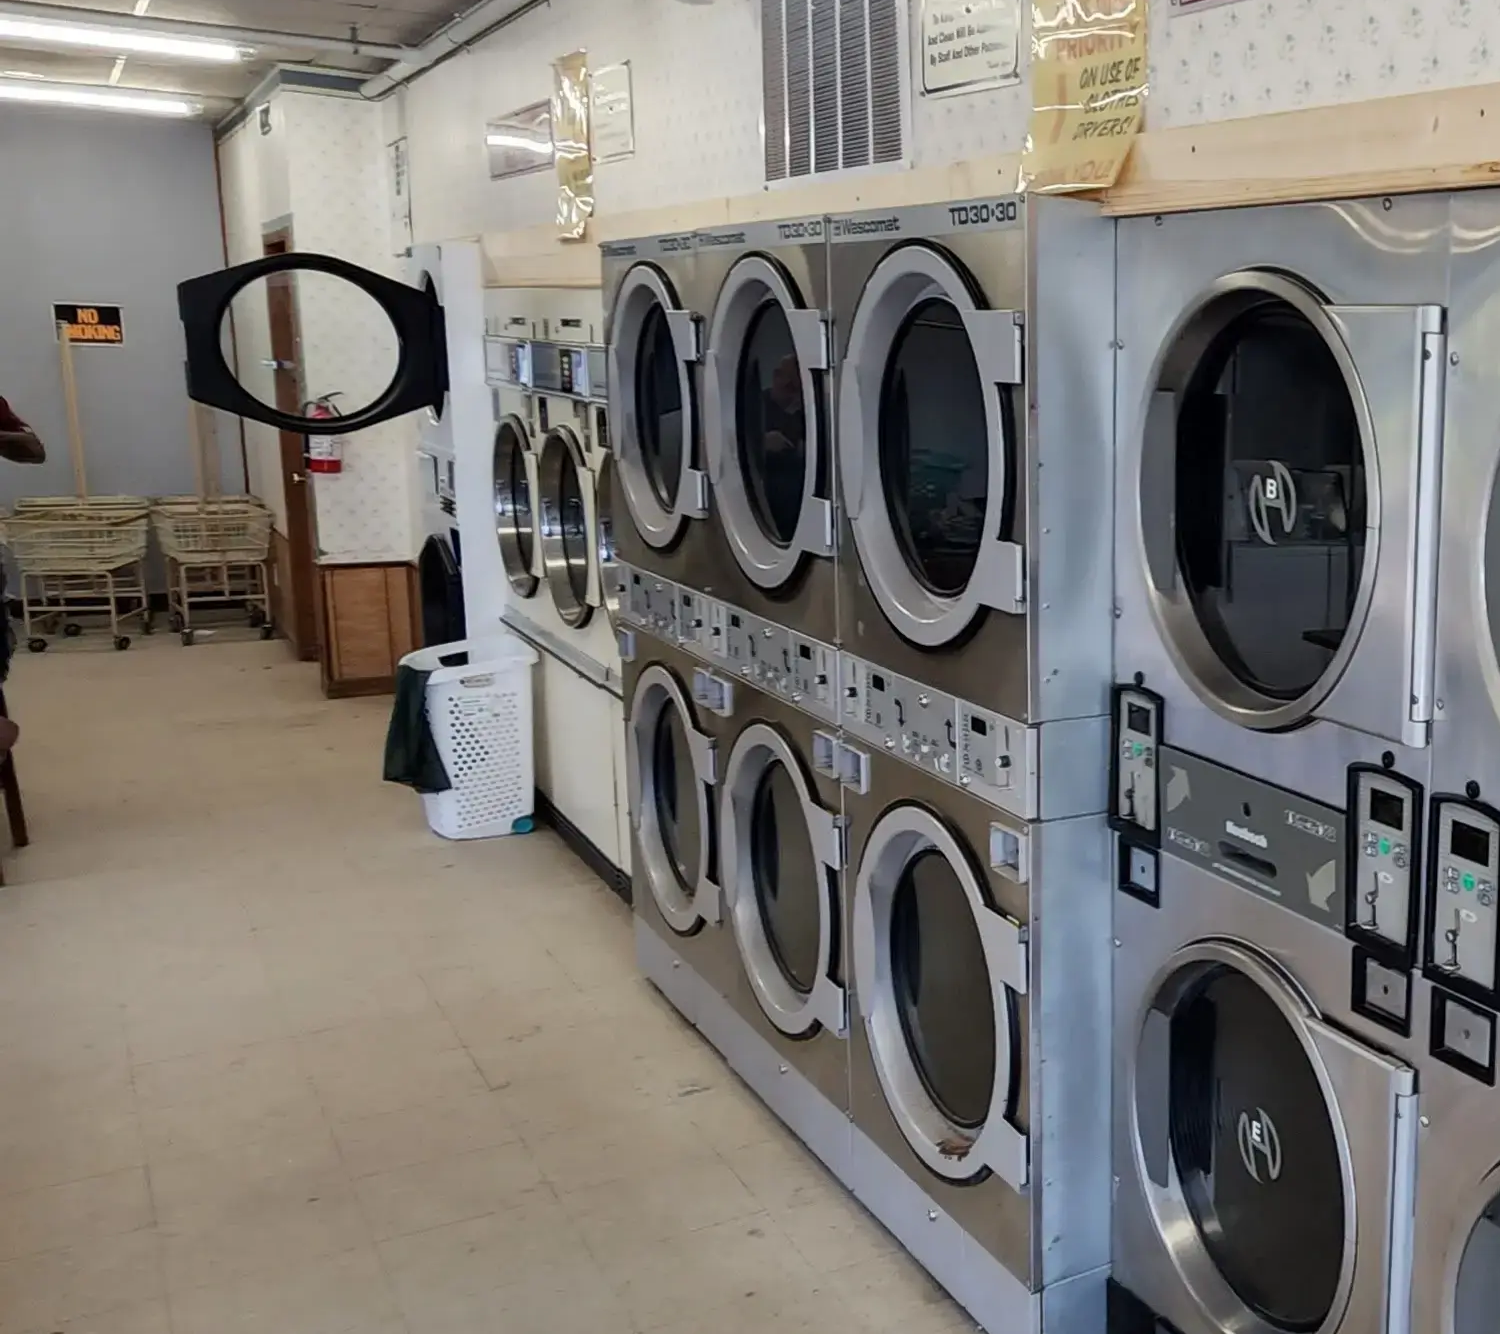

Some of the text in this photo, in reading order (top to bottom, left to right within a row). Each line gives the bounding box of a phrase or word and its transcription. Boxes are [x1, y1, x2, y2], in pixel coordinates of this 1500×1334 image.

[1056, 21, 1140, 60] PRIORITY
[1080, 58, 1141, 89] ON USE OF
[1085, 87, 1139, 114] CLOTHES
[1073, 115, 1135, 141] DRYERS!
[76, 308, 99, 324] NO
[66, 323, 121, 340] MOKING
[1266, 478, 1277, 499] B
[1252, 1120, 1261, 1143] E
